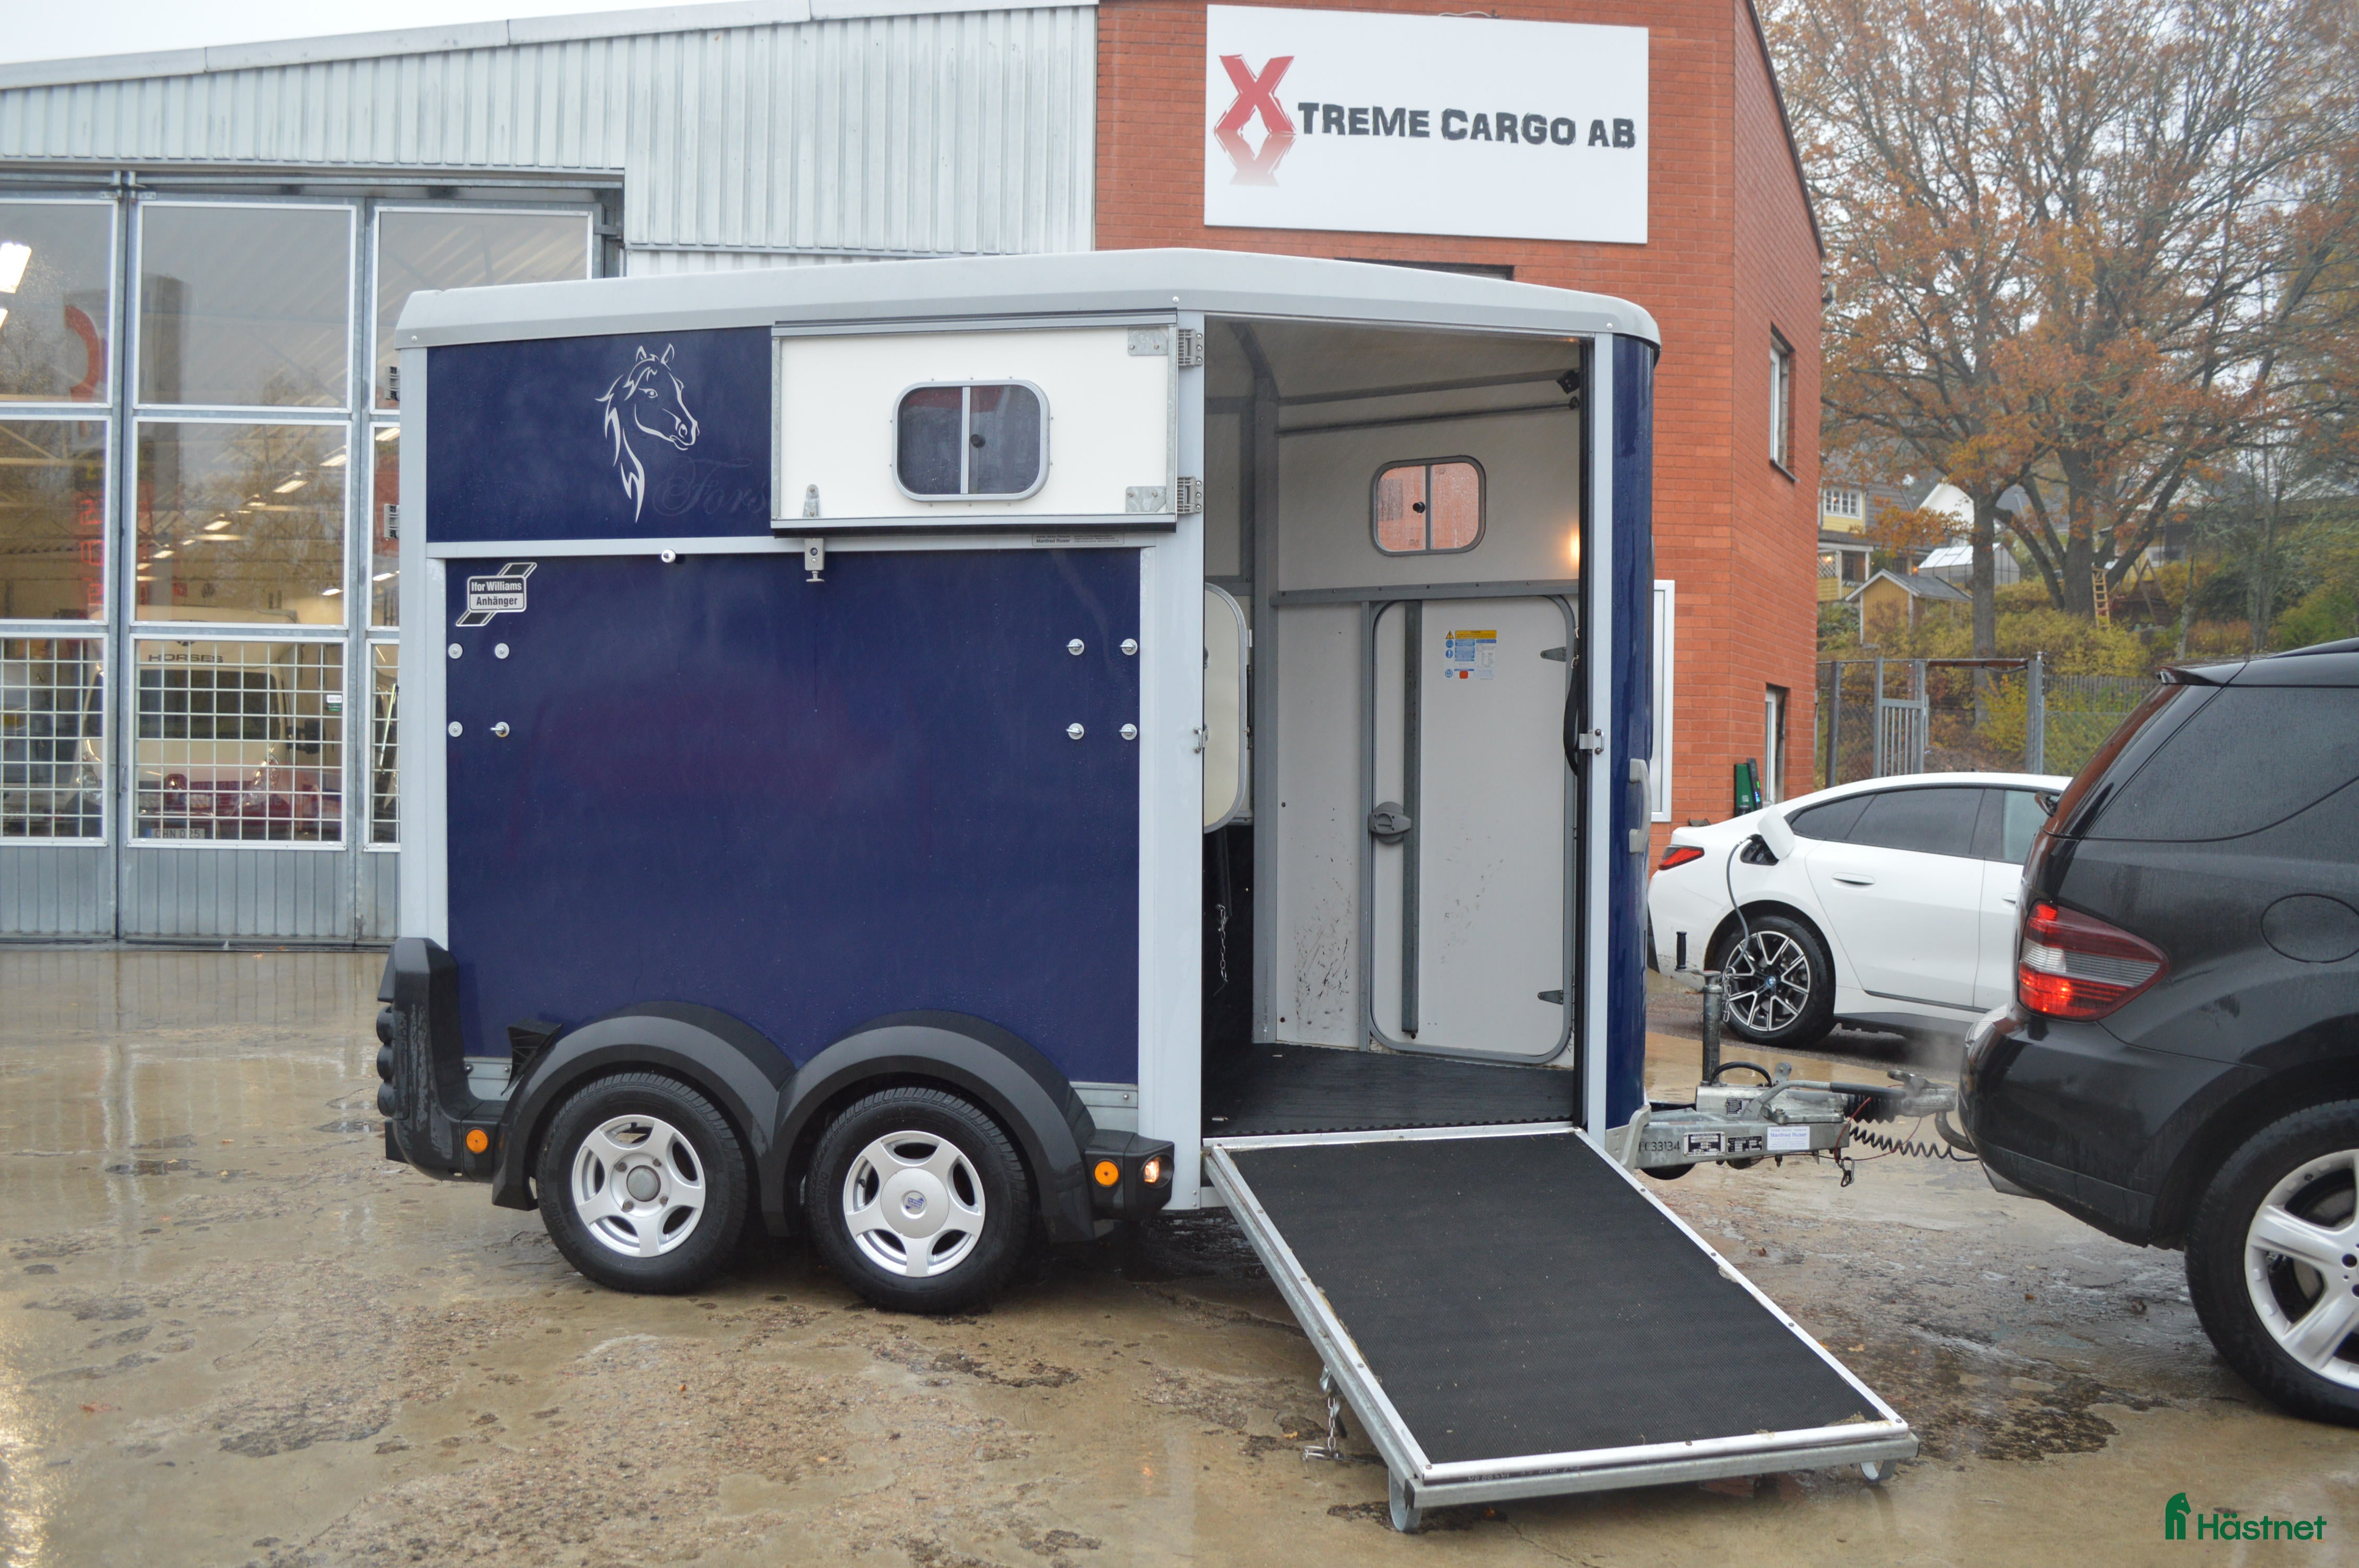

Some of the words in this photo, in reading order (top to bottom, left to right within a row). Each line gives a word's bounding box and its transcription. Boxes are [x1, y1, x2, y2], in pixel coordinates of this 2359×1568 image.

[1441, 108, 1576, 145] CARGO
[1588, 119, 1636, 148] AB
[471, 582, 485, 592] Ifor
[486, 581, 522, 591] Williams
[476, 596, 518, 607] Anhänger
[149, 654, 223, 663] HORSES
